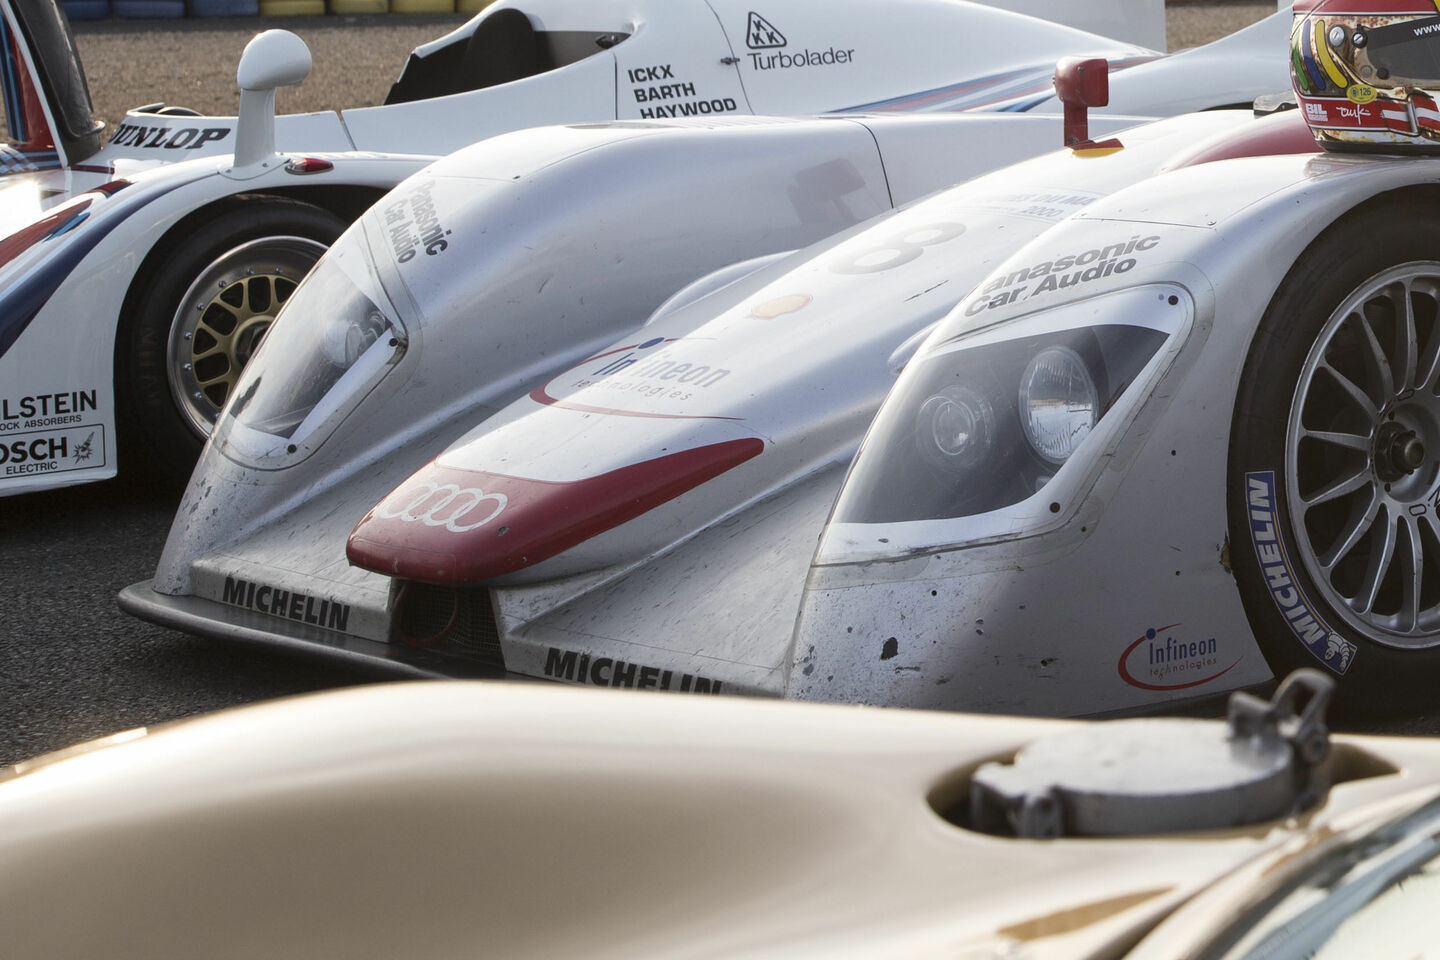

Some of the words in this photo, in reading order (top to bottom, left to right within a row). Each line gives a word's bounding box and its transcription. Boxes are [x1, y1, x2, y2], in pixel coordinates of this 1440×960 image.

[747, 47, 855, 71] Turbolader
[628, 64, 675, 84] ICKX
[634, 82, 697, 102] BARTH
[640, 98, 737, 120] HAYWOOD
[1306, 103, 1328, 115] BIL
[384, 198, 409, 226] Car
[408, 179, 452, 256] Panasonic
[389, 220, 420, 264] Audio
[828, 222, 967, 275] 8
[982, 235, 1161, 295] anasonic
[964, 283, 1029, 318] Car
[1030, 257, 1137, 302] Audio
[24, 415, 82, 428] ABSORBERS
[6, 461, 58, 475] ELECTRIC
[1249, 478, 1325, 645] MICHELIN
[223, 576, 350, 632] MICHELIN
[1149, 637, 1217, 665] Infineon
[544, 647, 723, 696] MICHELIN
[1149, 657, 1217, 676] technologies
